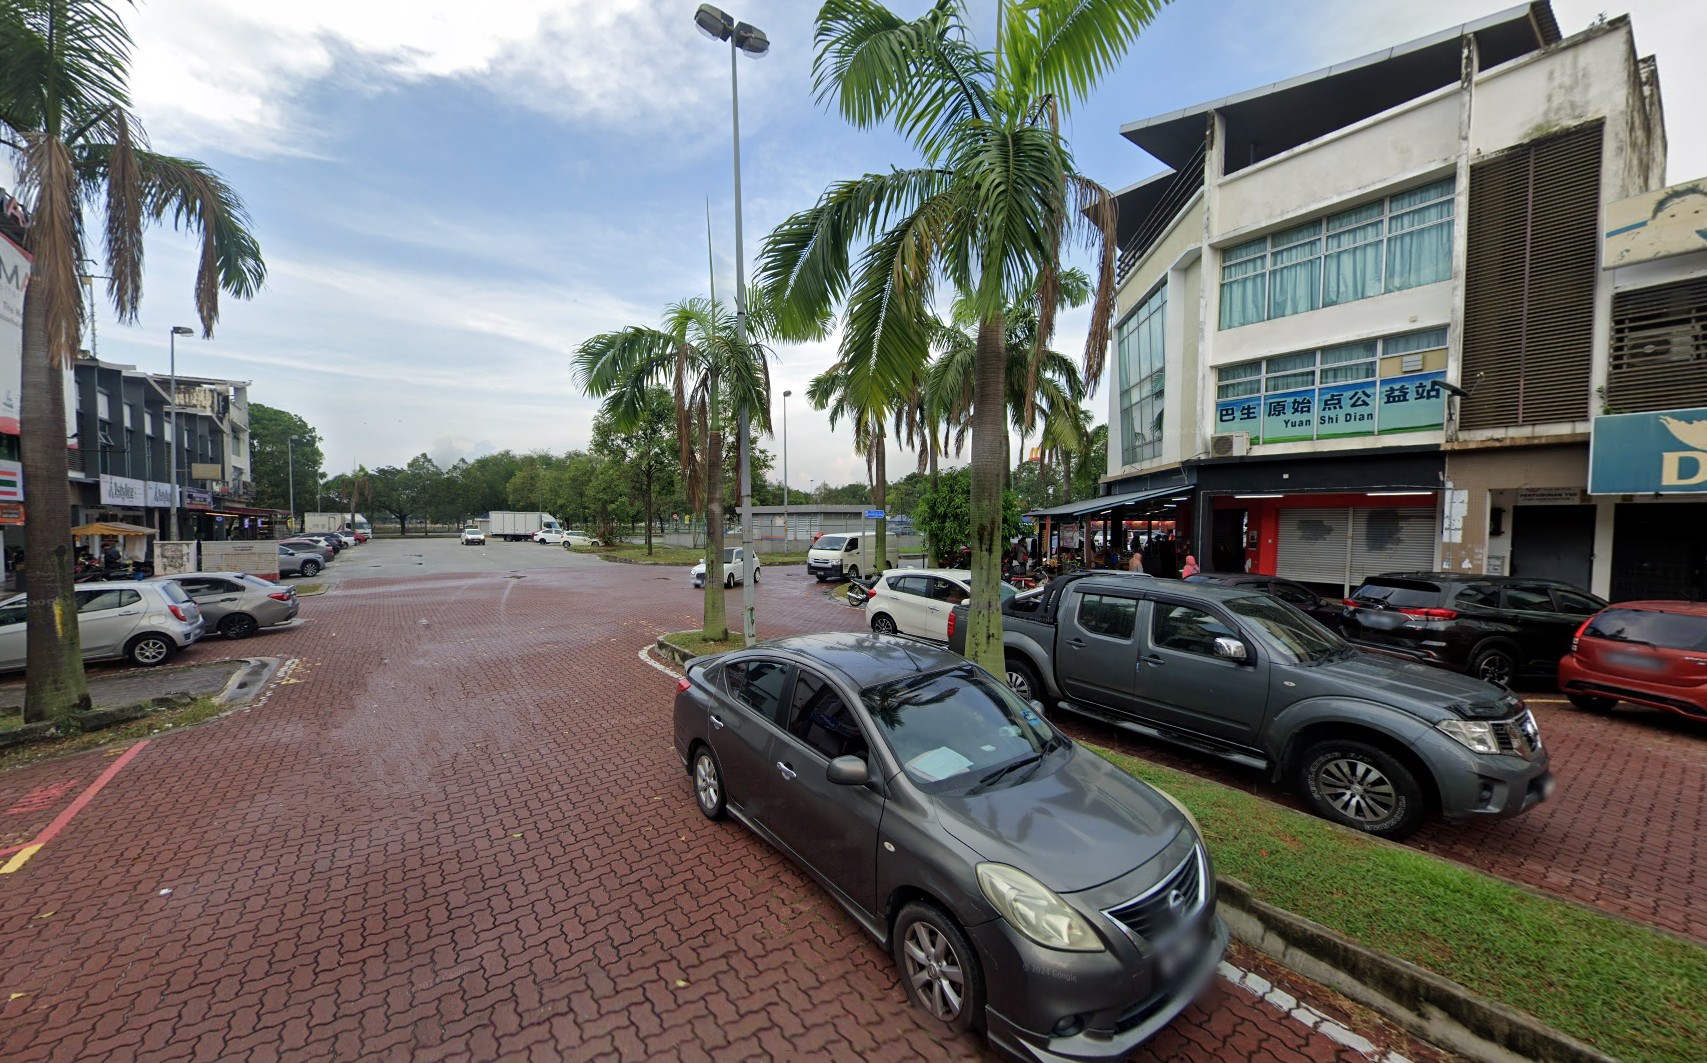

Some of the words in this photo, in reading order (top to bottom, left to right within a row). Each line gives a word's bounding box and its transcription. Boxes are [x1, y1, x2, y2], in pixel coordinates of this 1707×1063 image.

[1219, 382, 1441, 422] 巴生原始点公益站
[1283, 418, 1311, 429] Yuan
[1319, 414, 1340, 425] Shi
[1345, 411, 1374, 423] Dian
